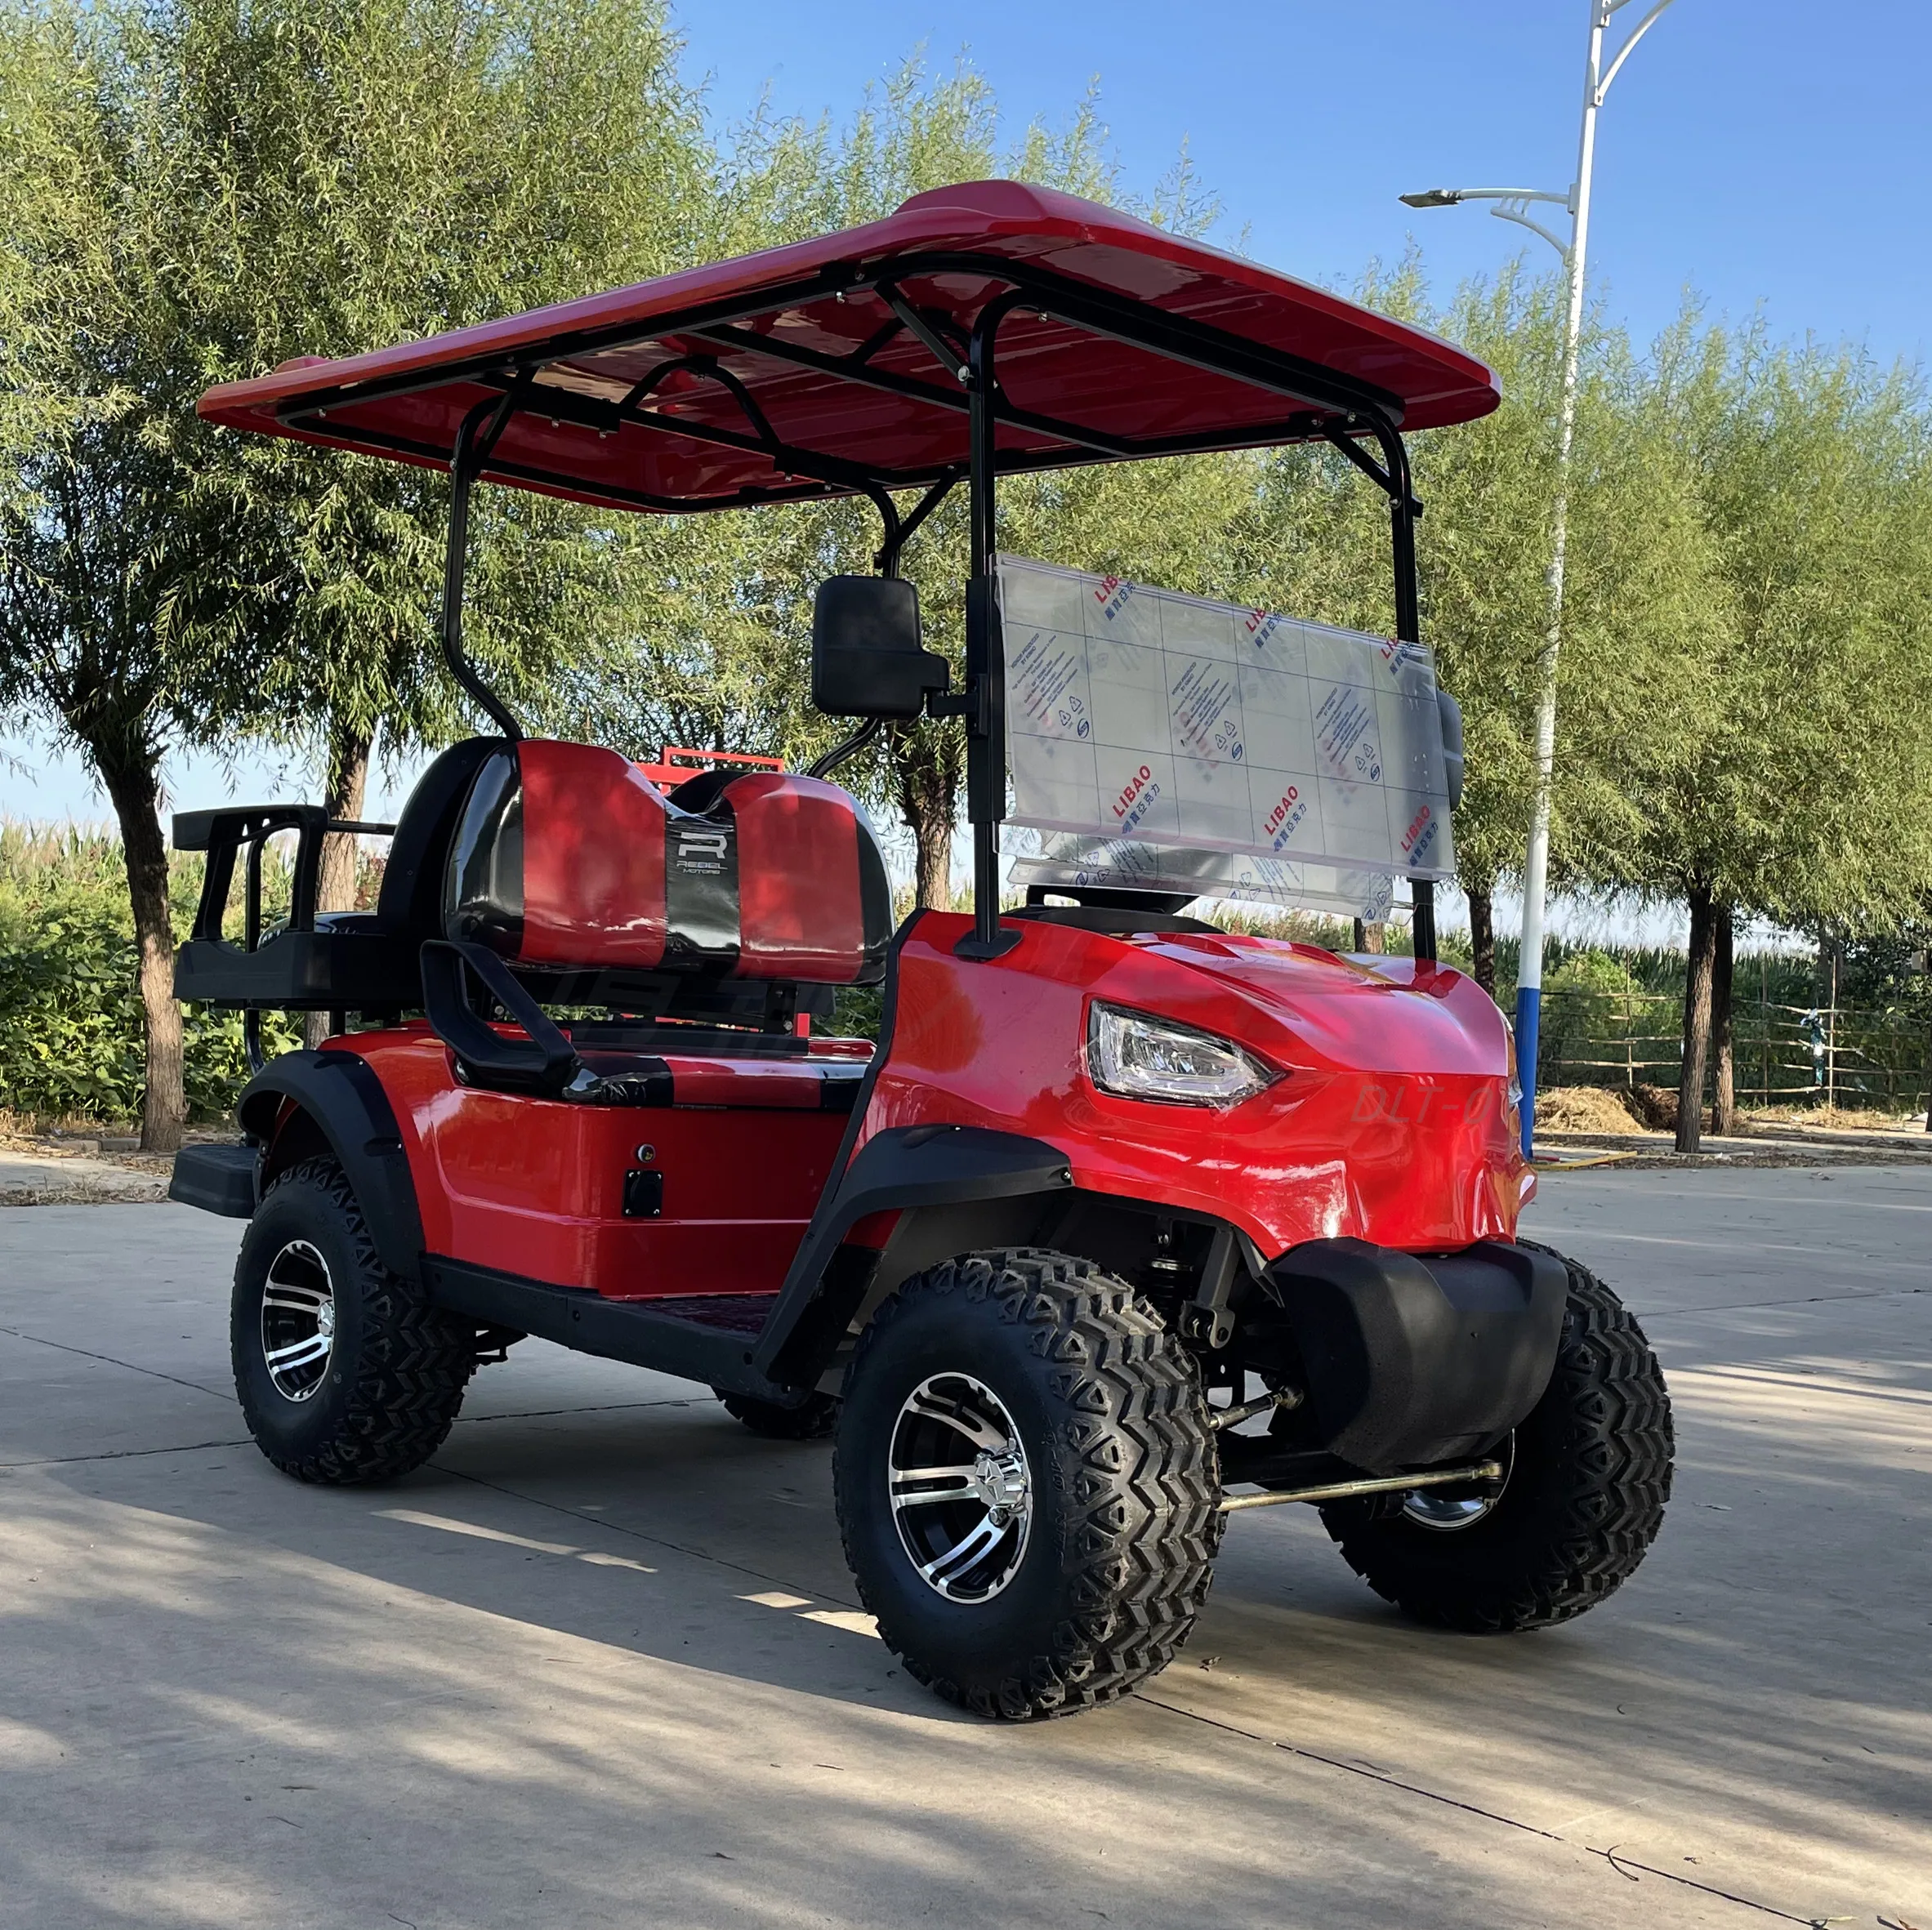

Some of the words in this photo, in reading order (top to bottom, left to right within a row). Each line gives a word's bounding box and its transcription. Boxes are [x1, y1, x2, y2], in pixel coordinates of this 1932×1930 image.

[1112, 764, 1151, 818] LIBAO
[1264, 785, 1298, 836] LIBAO
[1400, 804, 1430, 852] LIBAO
